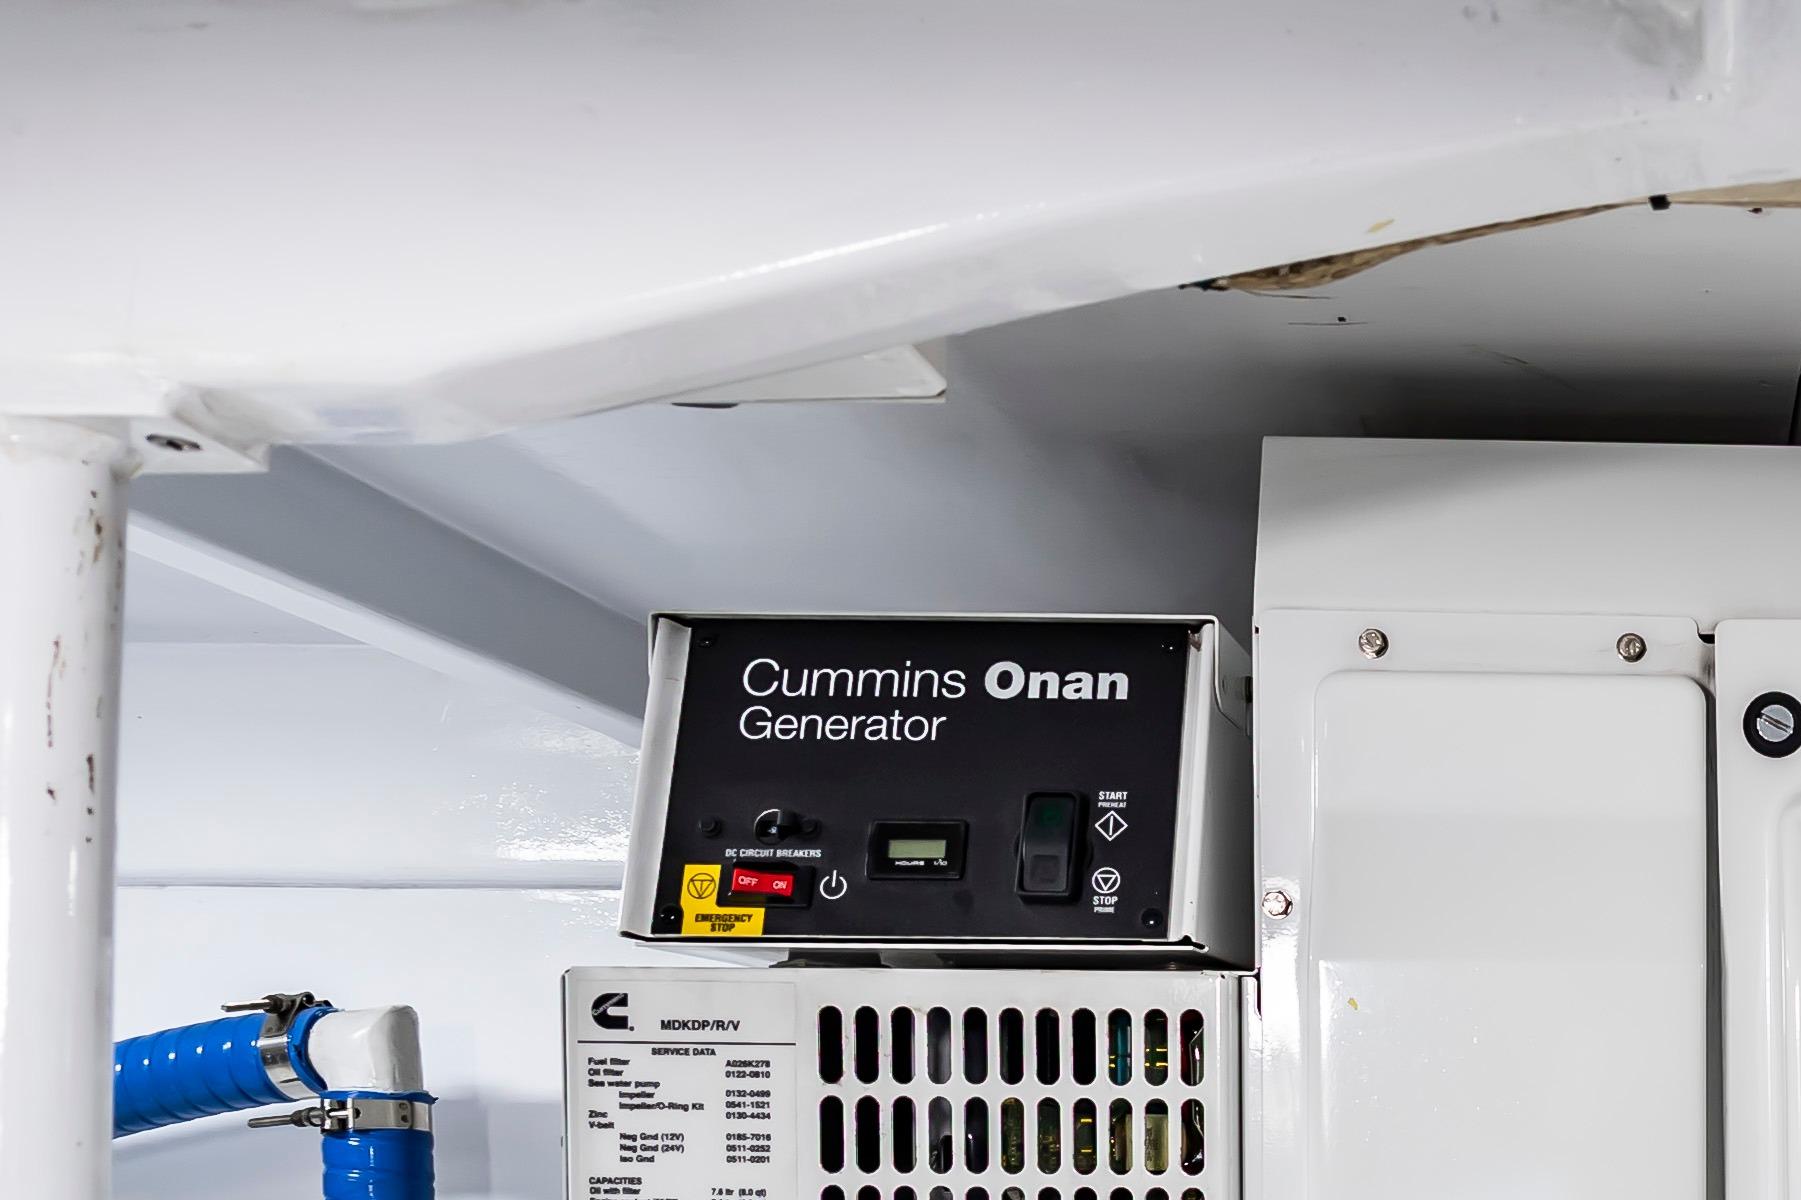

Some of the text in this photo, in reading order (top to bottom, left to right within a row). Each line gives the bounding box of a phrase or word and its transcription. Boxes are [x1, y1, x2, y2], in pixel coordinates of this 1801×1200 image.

[743, 658, 1128, 699] Cummins Onan
[740, 706, 947, 741] Generator
[1099, 791, 1127, 800] START
[725, 849, 821, 857] DC CIRCUIT BREAKERS
[738, 876, 787, 890] OFF ON
[1093, 896, 1118, 905] STOP
[695, 914, 753, 924] EMERGENCY
[710, 923, 735, 932] STOP
[661, 1020, 740, 1031] MDKDP/R/V
[651, 1048, 716, 1056] SERVICE DATA
[588, 1057, 607, 1065] Fuel
[634, 1081, 660, 1089] pump
[620, 1132, 684, 1142] Neg Gnd (12V)
[620, 1144, 638, 1153] Neg
[640, 1144, 659, 1152] Gnd
[589, 1177, 642, 1185] CAPACITIES
